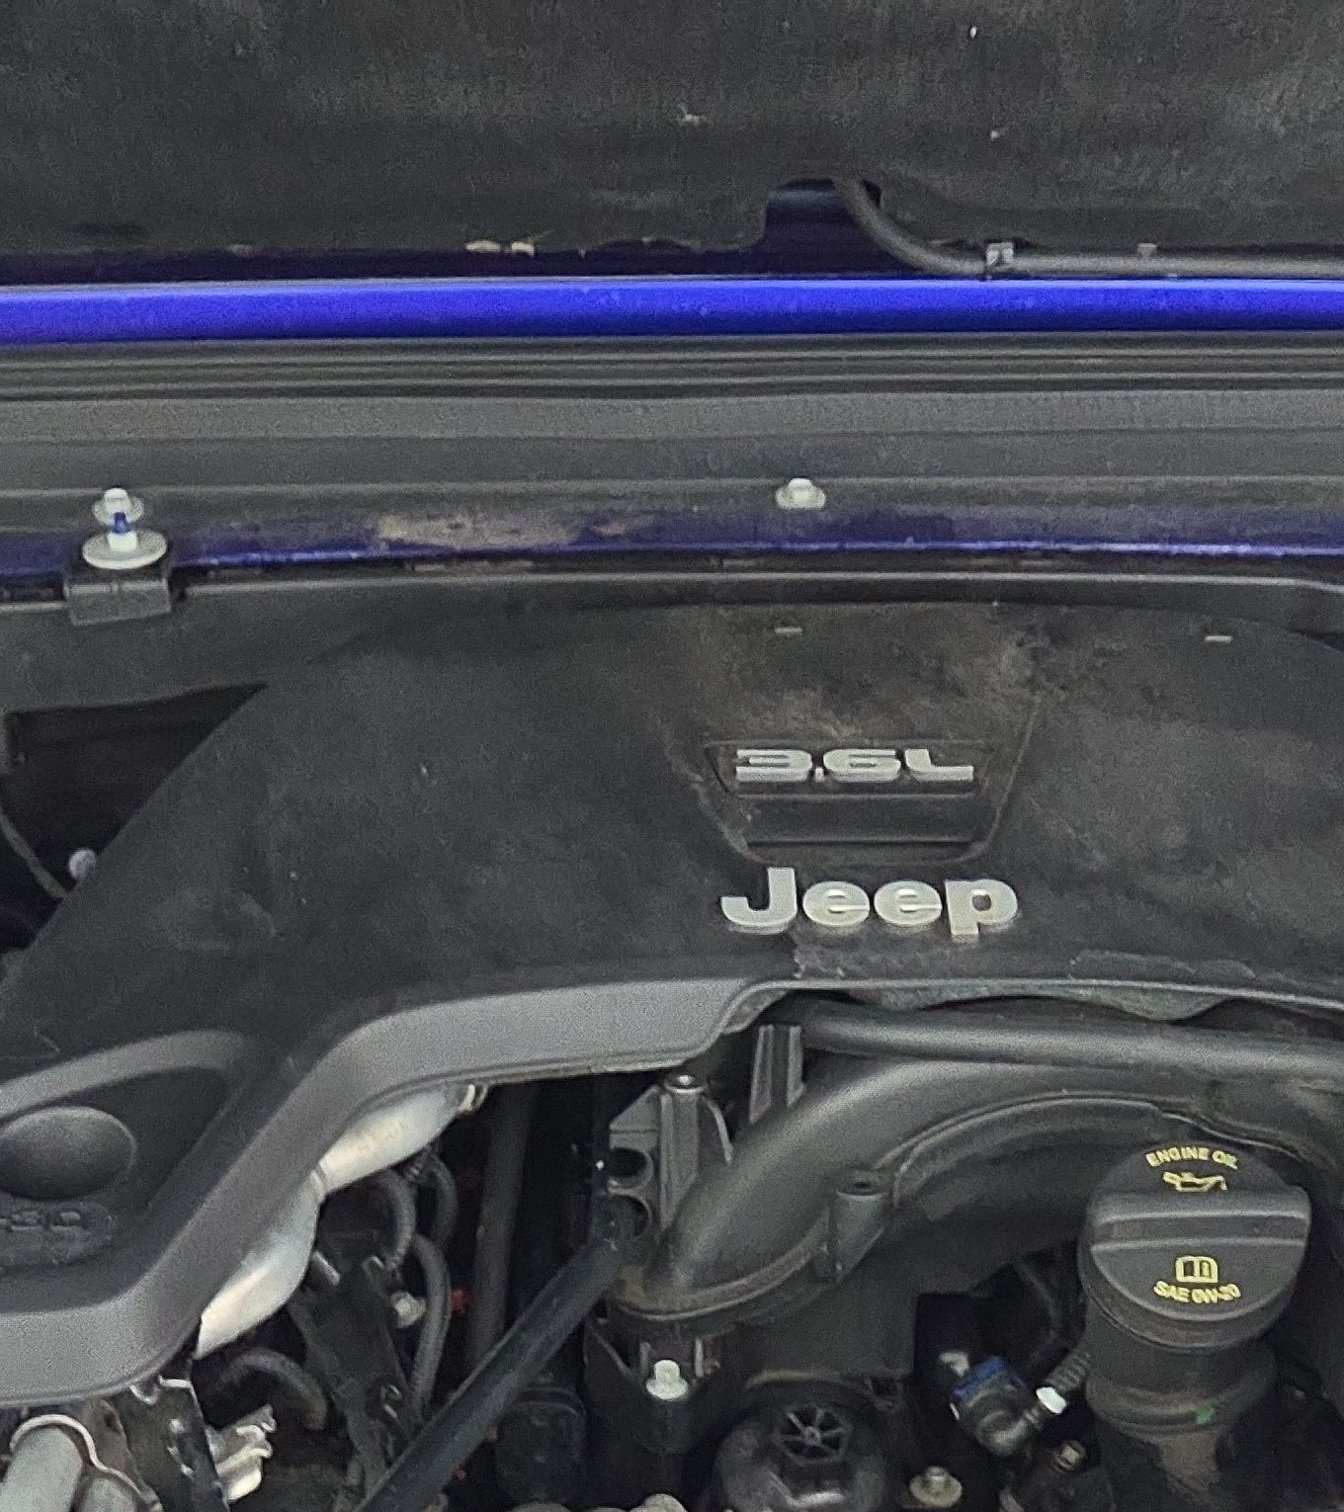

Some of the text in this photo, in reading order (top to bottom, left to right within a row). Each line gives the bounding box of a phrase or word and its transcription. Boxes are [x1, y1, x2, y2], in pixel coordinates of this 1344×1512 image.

[735, 747, 975, 783] 3.6L
[720, 866, 1019, 936] Jeep
[1145, 1146, 1239, 1171] ENGINE OIL
[1153, 1280, 1191, 1303] SAE
